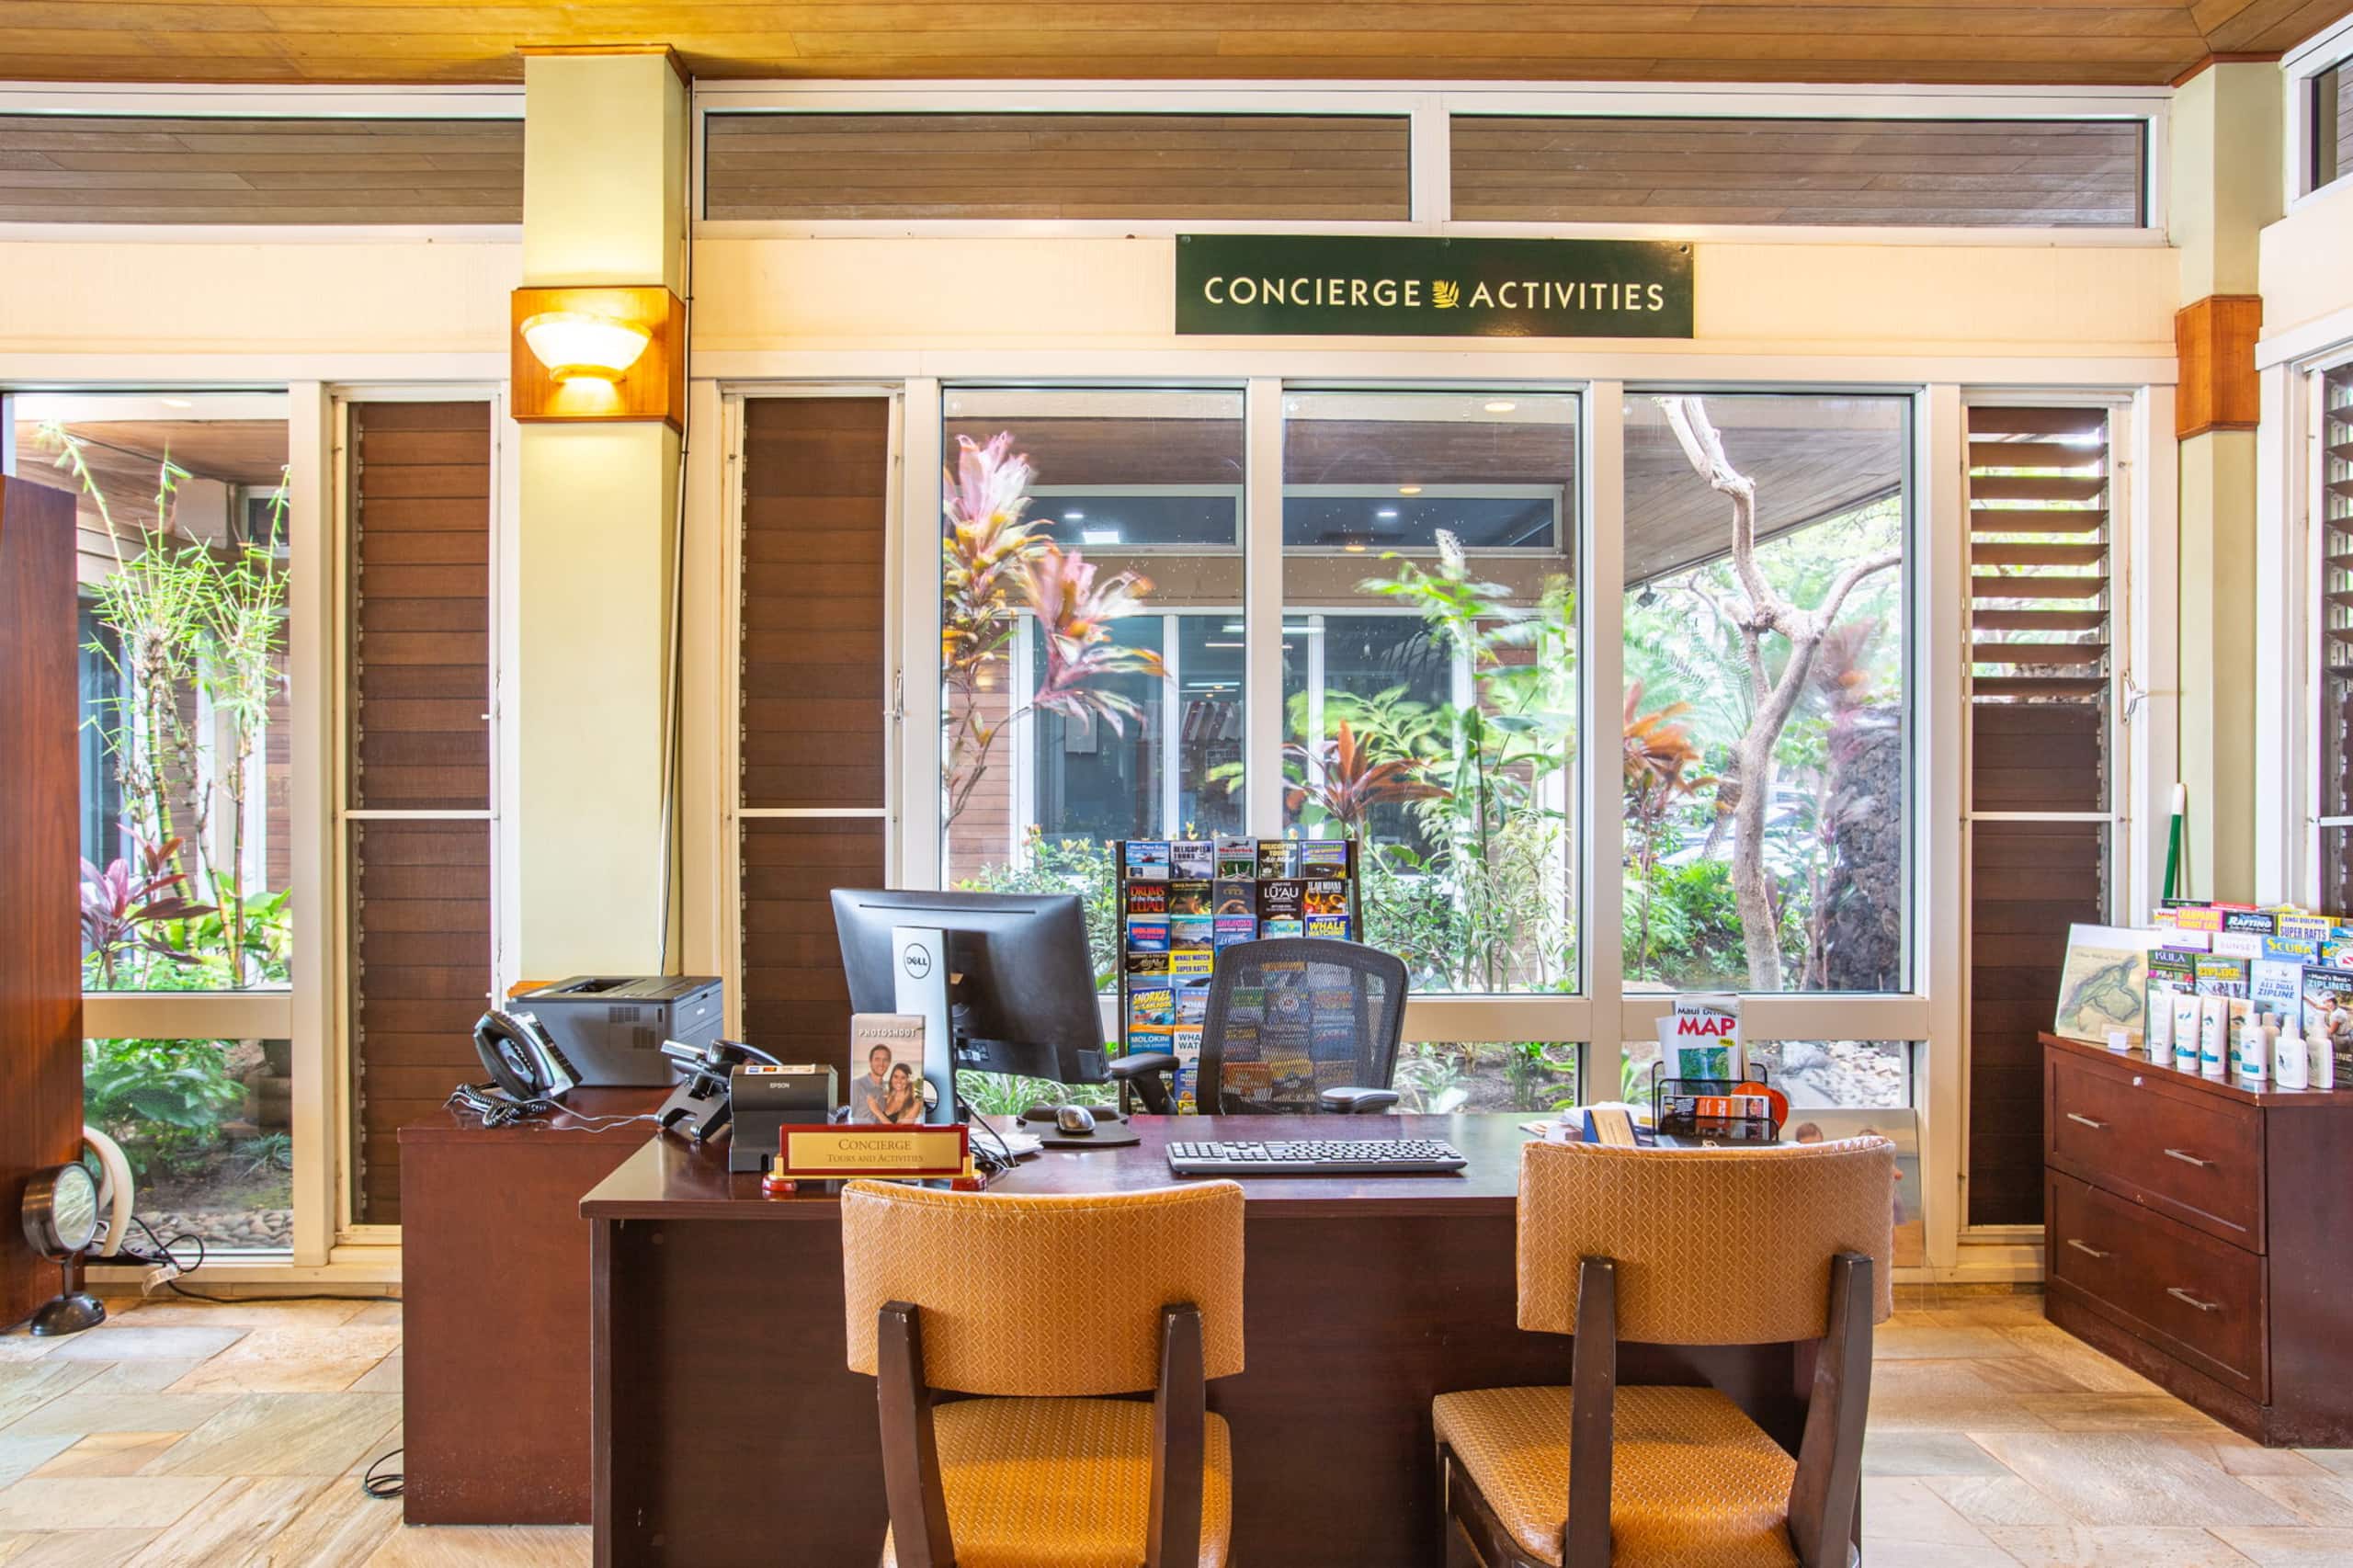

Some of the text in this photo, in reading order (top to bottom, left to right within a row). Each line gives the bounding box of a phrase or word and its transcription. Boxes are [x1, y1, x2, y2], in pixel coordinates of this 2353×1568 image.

[1203, 277, 1665, 312] CONCIERGE ACTIVITIES
[1130, 885, 1165, 897] DRUMS
[1309, 921, 1346, 931] WHALE
[2227, 915, 2272, 928] RAFTING
[2279, 926, 2302, 938] SUPER
[2304, 927, 2326, 940] RAFTS
[2267, 937, 2313, 955] SCUBA
[906, 956, 927, 966] DELL
[2154, 950, 2186, 963] KULA
[2307, 980, 2352, 993] ZIPLINES
[1133, 991, 1171, 1004] SNORKEL
[2257, 988, 2295, 999] ZIPLINE
[1677, 1006, 1699, 1015] Maui
[858, 1028, 916, 1038] PHOTOSHOOT
[1677, 1016, 1736, 1037] MAP
